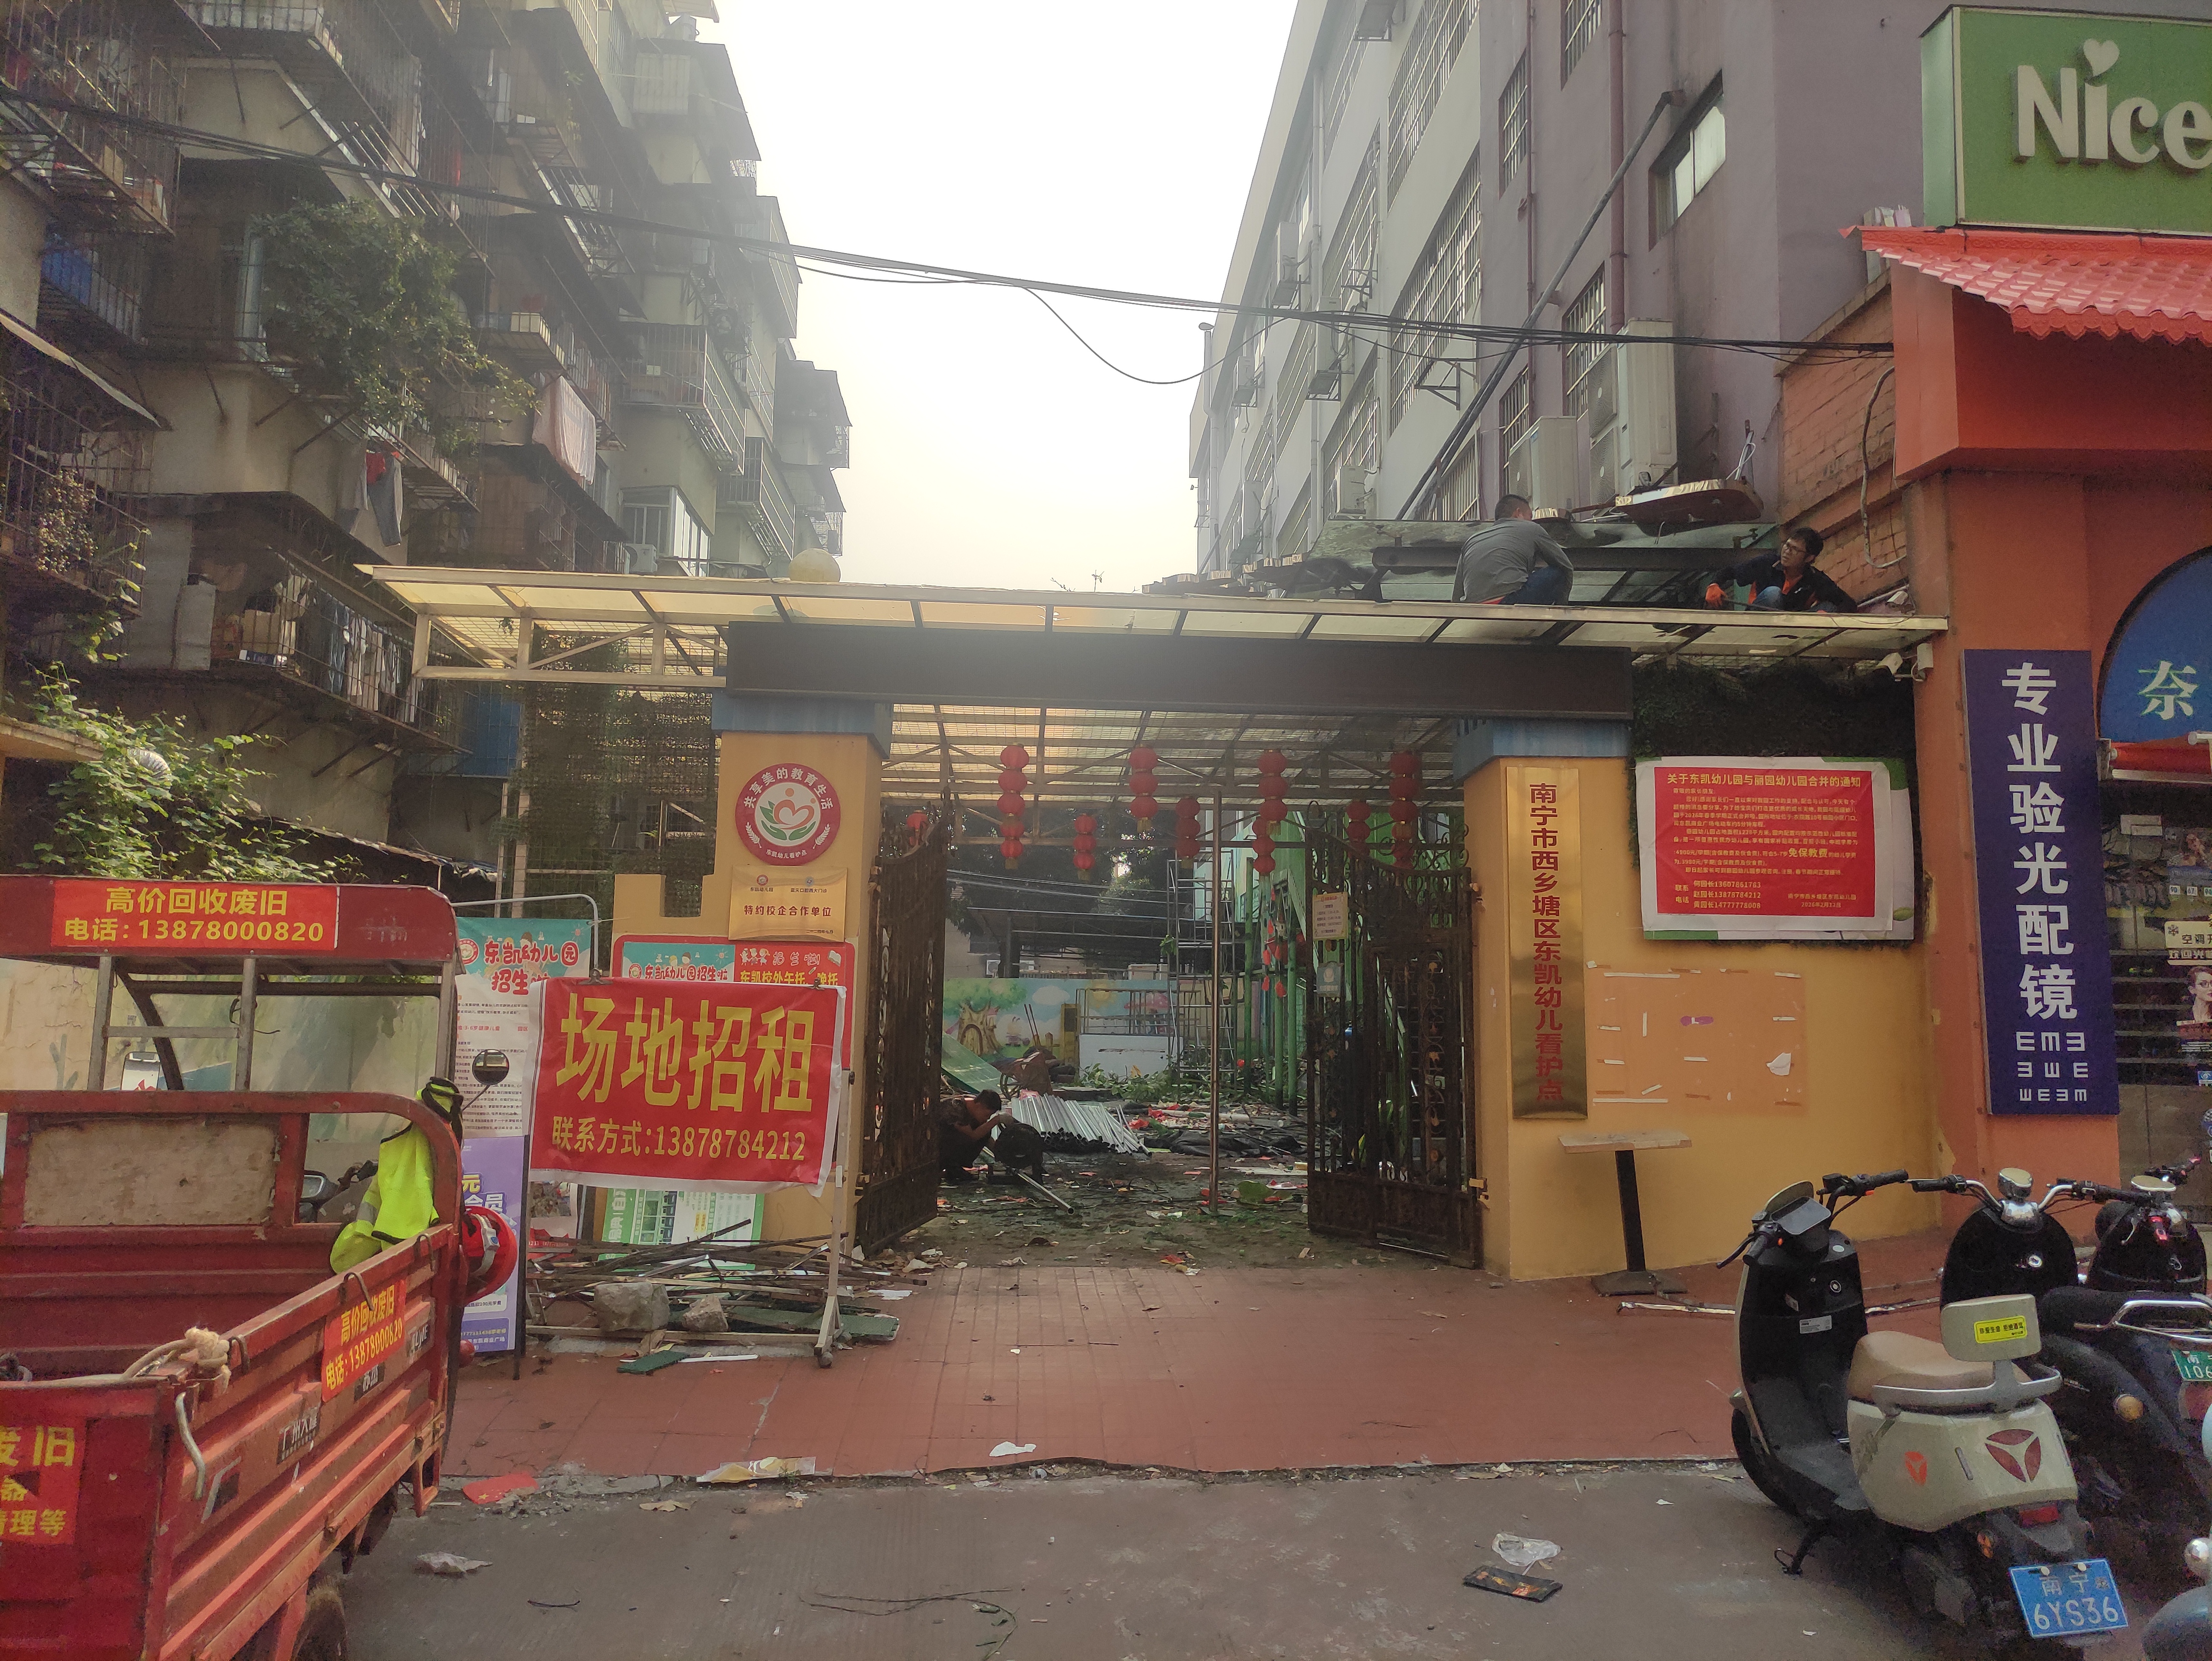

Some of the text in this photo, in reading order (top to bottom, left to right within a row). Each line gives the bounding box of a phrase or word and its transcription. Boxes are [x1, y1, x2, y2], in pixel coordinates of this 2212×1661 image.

[2017, 39, 2212, 170] Nice
[2137, 660, 2200, 720] 奈
[744, 767, 834, 809] 共享美的教育生活
[1667, 774, 1861, 787] 关于东凯幼儿园与丽园幼儿园合并的通知
[2002, 662, 2078, 1020] 专业验光配镜
[105, 886, 288, 916] 高价回收废旧
[744, 905, 832, 917] 特约校企合作单位
[65, 917, 324, 942] 电话：13878000820
[1529, 783, 1564, 1101] 南宁市西乡塘区东凯幼儿看护点
[484, 940, 579, 967] 东凯幼儿园
[491, 969, 551, 996] 招生
[645, 964, 728, 981] 东凯幼儿园招生啦
[556, 993, 815, 1113] 场地招租
[552, 1116, 806, 1161] 联系方式:13878784212
[462, 1174, 481, 1194] 元
[2034, 1596, 2119, 1630] 6YS36
